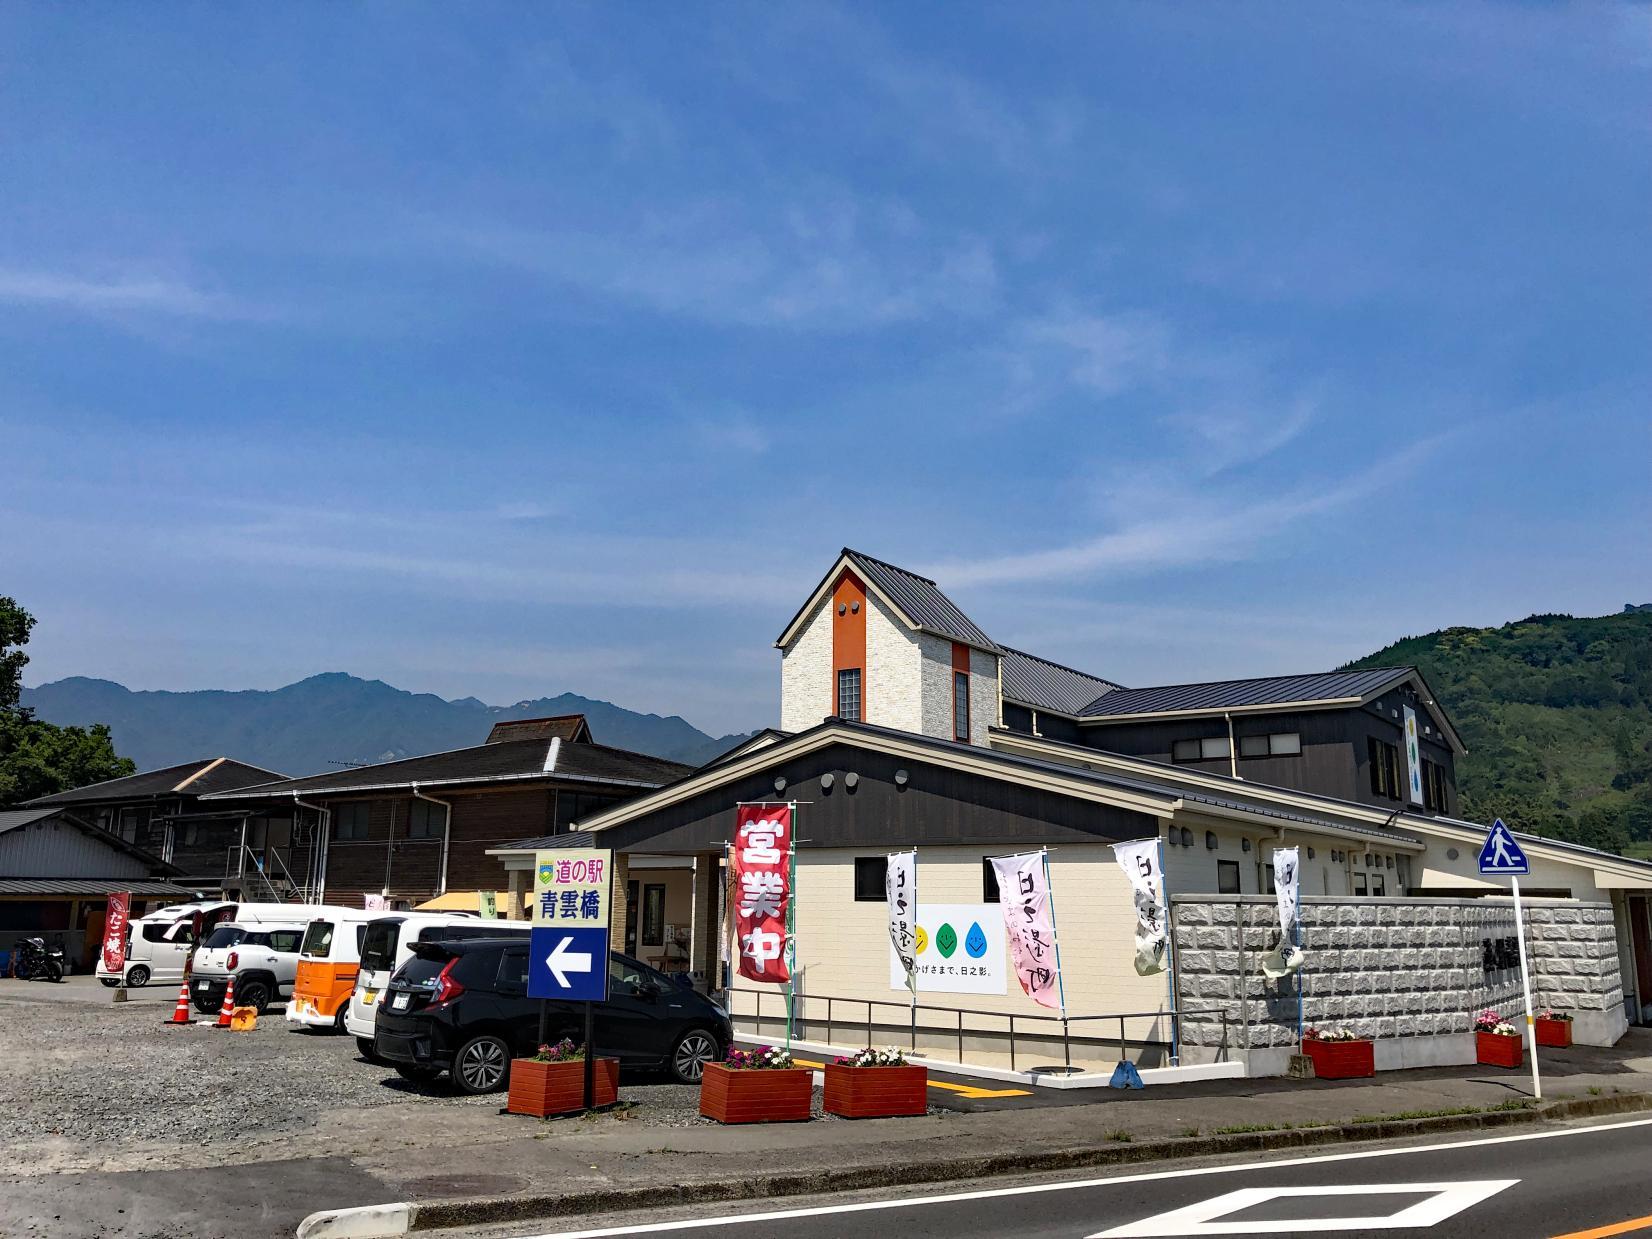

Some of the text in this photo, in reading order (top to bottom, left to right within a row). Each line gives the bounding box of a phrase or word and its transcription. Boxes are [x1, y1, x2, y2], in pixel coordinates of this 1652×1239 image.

[555, 859, 604, 884] 道の駅
[540, 889, 601, 919] 青雲橋
[740, 820, 784, 974] 営業中
[106, 911, 123, 954] たこ焼
[915, 965, 992, 977] かげさまで、日之影。
